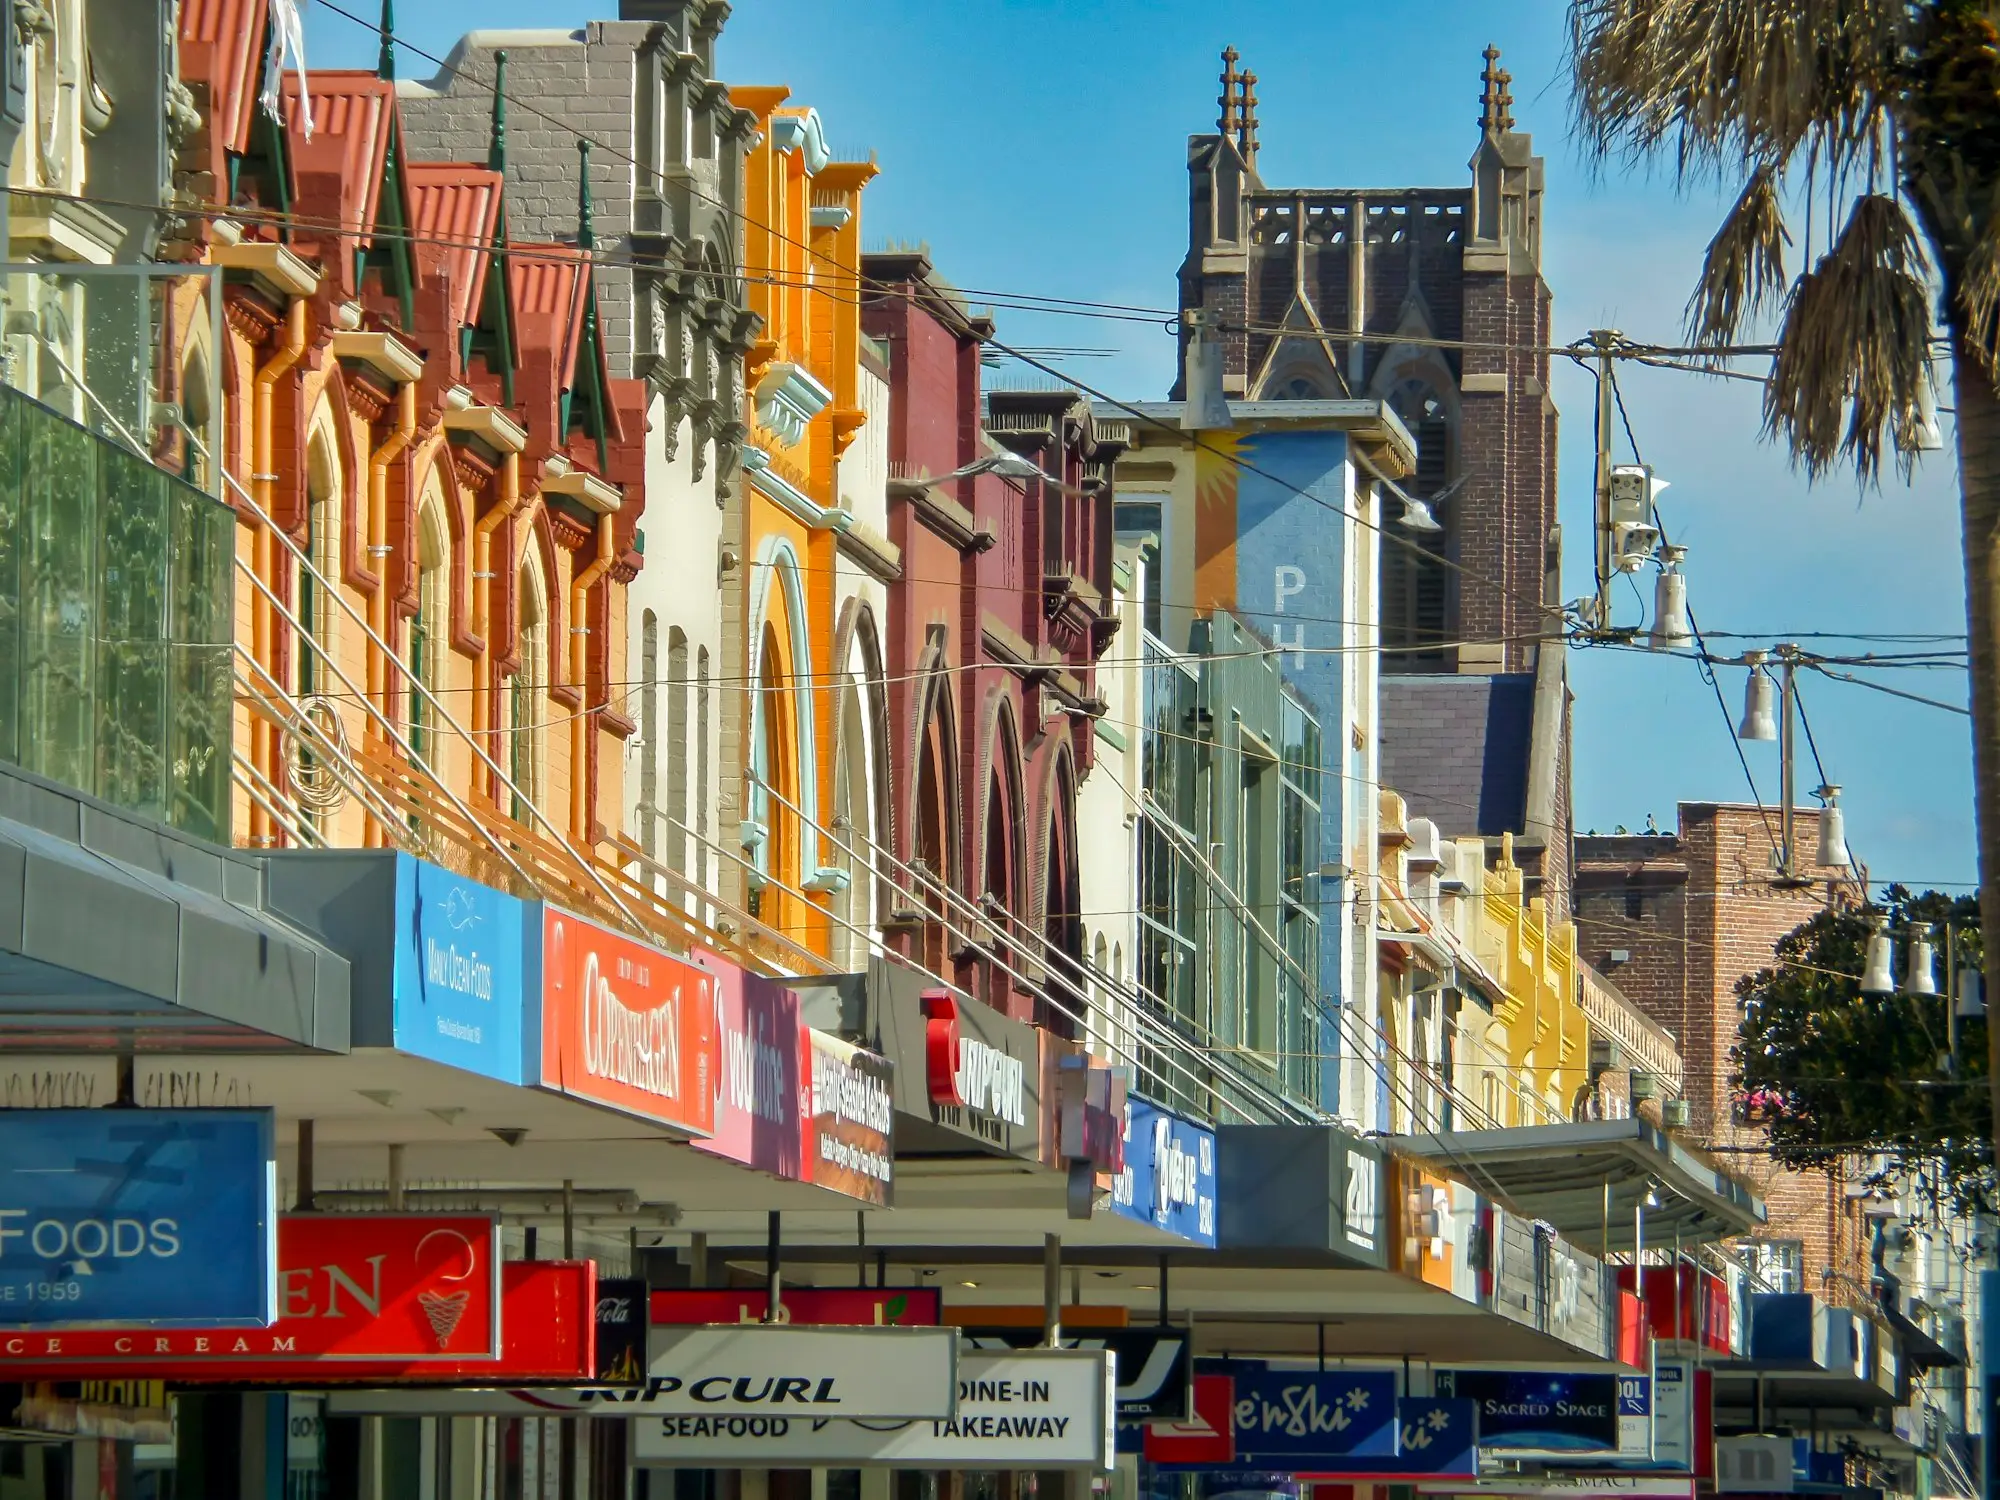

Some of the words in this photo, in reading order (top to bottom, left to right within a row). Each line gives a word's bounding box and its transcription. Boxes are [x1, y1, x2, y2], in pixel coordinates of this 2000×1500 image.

[585, 952, 681, 1101] COPENHAGEN
[728, 1008, 784, 1125] vodafone
[0, 1209, 181, 1258] FOODS
[25, 1282, 81, 1301] 1959
[114, 1336, 295, 1354] CREAM
[688, 1377, 842, 1404] CURL
[1484, 1399, 1550, 1417] SACRED
[1555, 1399, 1608, 1418] SPACE
[661, 1416, 789, 1438] SEAFOOD
